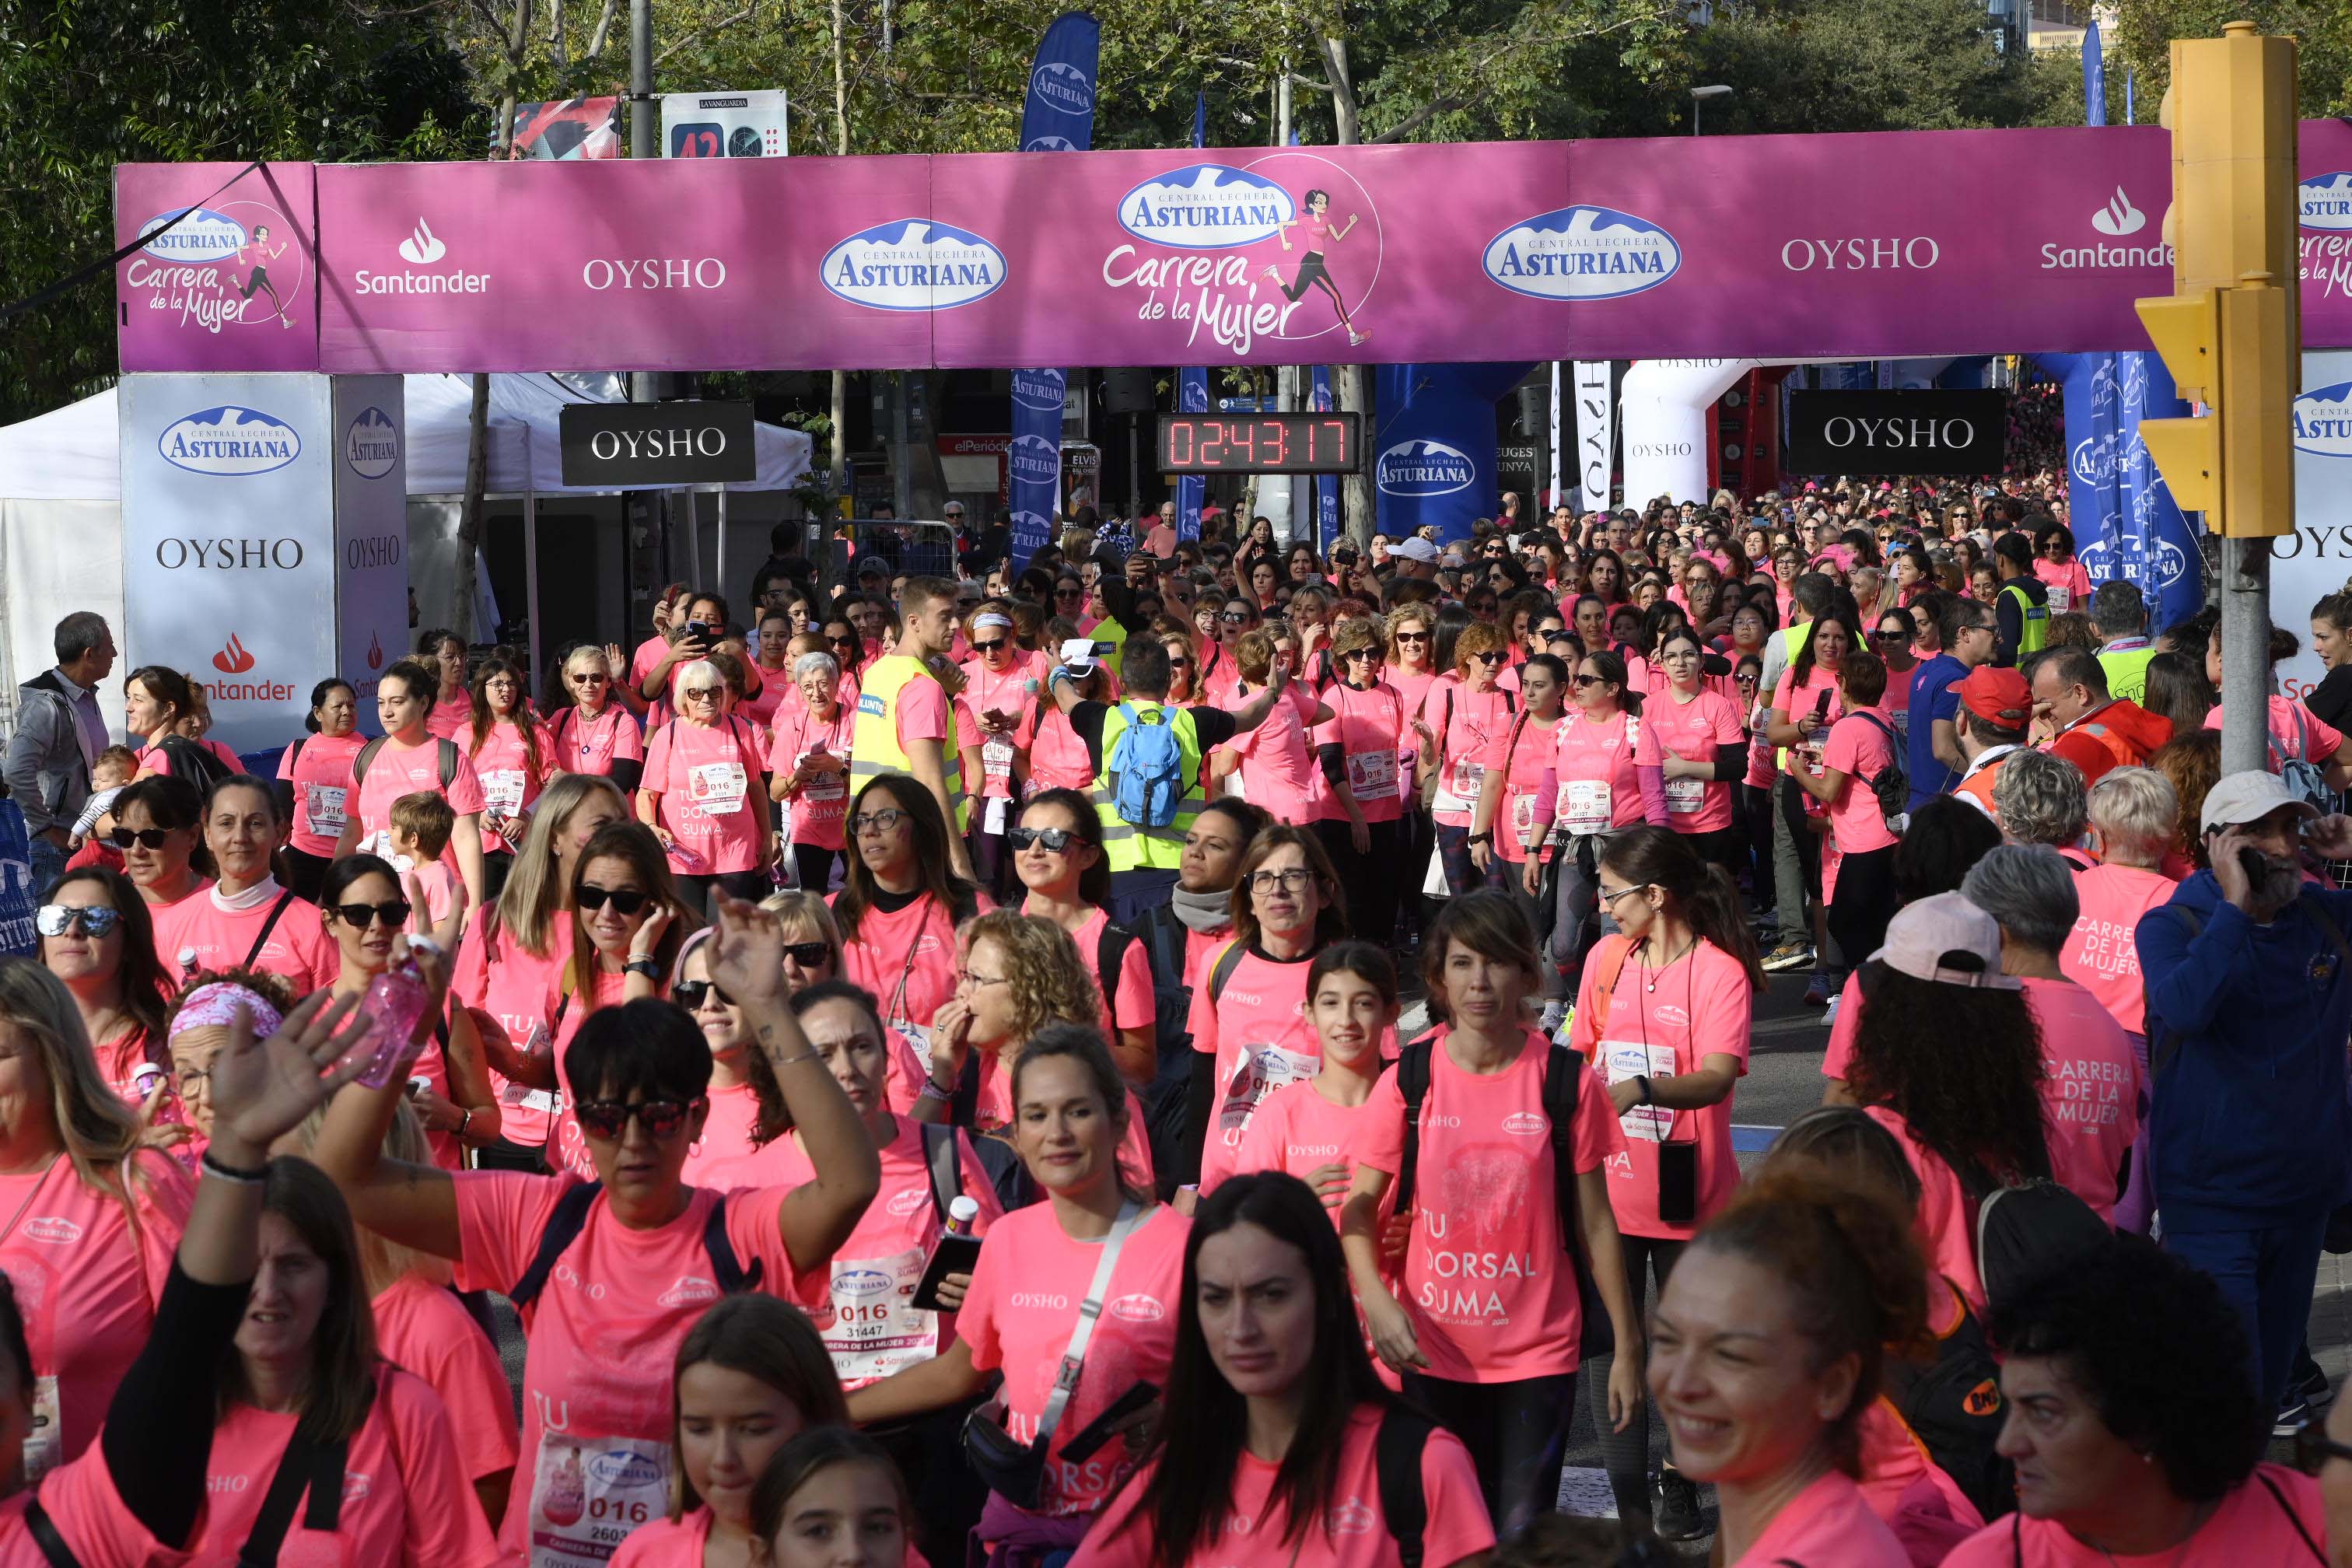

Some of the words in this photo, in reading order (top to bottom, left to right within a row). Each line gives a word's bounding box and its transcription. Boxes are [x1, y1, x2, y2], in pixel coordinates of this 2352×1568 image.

[708, 100, 747, 108] VANGUARDIA
[1158, 192, 1214, 203] CENTRAL
[1219, 192, 1276, 202] LECHERA
[1131, 196, 1281, 228] ASTURIANA
[1528, 238, 1589, 250] CENTRAL
[1594, 236, 1660, 248] LECHERA
[1782, 236, 1940, 272] OYSHO
[863, 250, 922, 261] CENTRAL
[927, 250, 987, 260] LECHERA
[1103, 244, 1248, 288] Carrera
[1497, 241, 1666, 278] ASTURIANA
[2041, 242, 2176, 270] Santande
[127, 258, 219, 289] Carrera
[583, 257, 726, 291] OYSHO
[834, 253, 993, 288] ASTURIANA
[2299, 258, 2309, 280] e
[2313, 257, 2328, 280] la
[355, 269, 492, 295] Santander
[149, 290, 167, 310] de
[170, 290, 183, 310] la
[180, 285, 254, 334] Mujer
[1138, 290, 1166, 320] de
[1172, 289, 1192, 320] la
[1186, 282, 1304, 356] Mujer
[191, 429, 237, 439] CENTRAL
[240, 429, 286, 438] LECHERA
[591, 427, 726, 460] OYSHO
[1171, 422, 1344, 464] 02:43:17
[1825, 417, 1975, 449] OYSHO
[169, 432, 292, 460] ASTURIANA
[350, 433, 396, 461] ASTURIANA
[1494, 447, 1533, 457] EUGES
[1633, 442, 1692, 458] OYSHO
[1073, 455, 1097, 465] ELVIS
[1496, 461, 1532, 472] UNYA
[1380, 462, 1468, 485] ASTURIANA
[156, 537, 304, 570] OYSHO
[348, 534, 400, 569] OYSHO
[200, 680, 296, 702] ntander
[355, 676, 379, 698] Santa
[1367, 769, 1382, 779] 016
[1667, 781, 1685, 789] 016
[711, 782, 730, 791] 016
[324, 806, 343, 815] 016
[808, 808, 845, 821] SUMA
[1571, 801, 1591, 810] 016
[682, 822, 723, 835] SUMA
[2075, 915, 2135, 941] CARRE
[2085, 935, 2110, 954] DE
[2116, 943, 2137, 959] LA
[2077, 951, 2138, 976] MUJER
[1220, 991, 1261, 1006] OYSHO
[1610, 999, 1629, 1010] SHO
[501, 1014, 535, 1033] TU
[2042, 1059, 2130, 1083] CARRERA
[1252, 1077, 1283, 1091] 016
[2065, 1081, 2091, 1101] DE
[2098, 1083, 2119, 1103] LA
[508, 1090, 537, 1102] OYSHO
[2057, 1101, 2119, 1125] MUJER
[1287, 1144, 1338, 1157] OYSHO
[1421, 1207, 1447, 1238] TU
[835, 1278, 891, 1292] ASTURIANA
[1012, 1292, 1069, 1311] OYSHO
[1419, 1281, 1506, 1316] SUMA
[841, 1303, 888, 1322] 016
[847, 1325, 884, 1338] 31447
[876, 1339, 905, 1348] MUJER
[593, 1458, 656, 1479] ASTURIANA
[205, 1474, 248, 1493] SHO
[590, 1497, 648, 1524] 016
